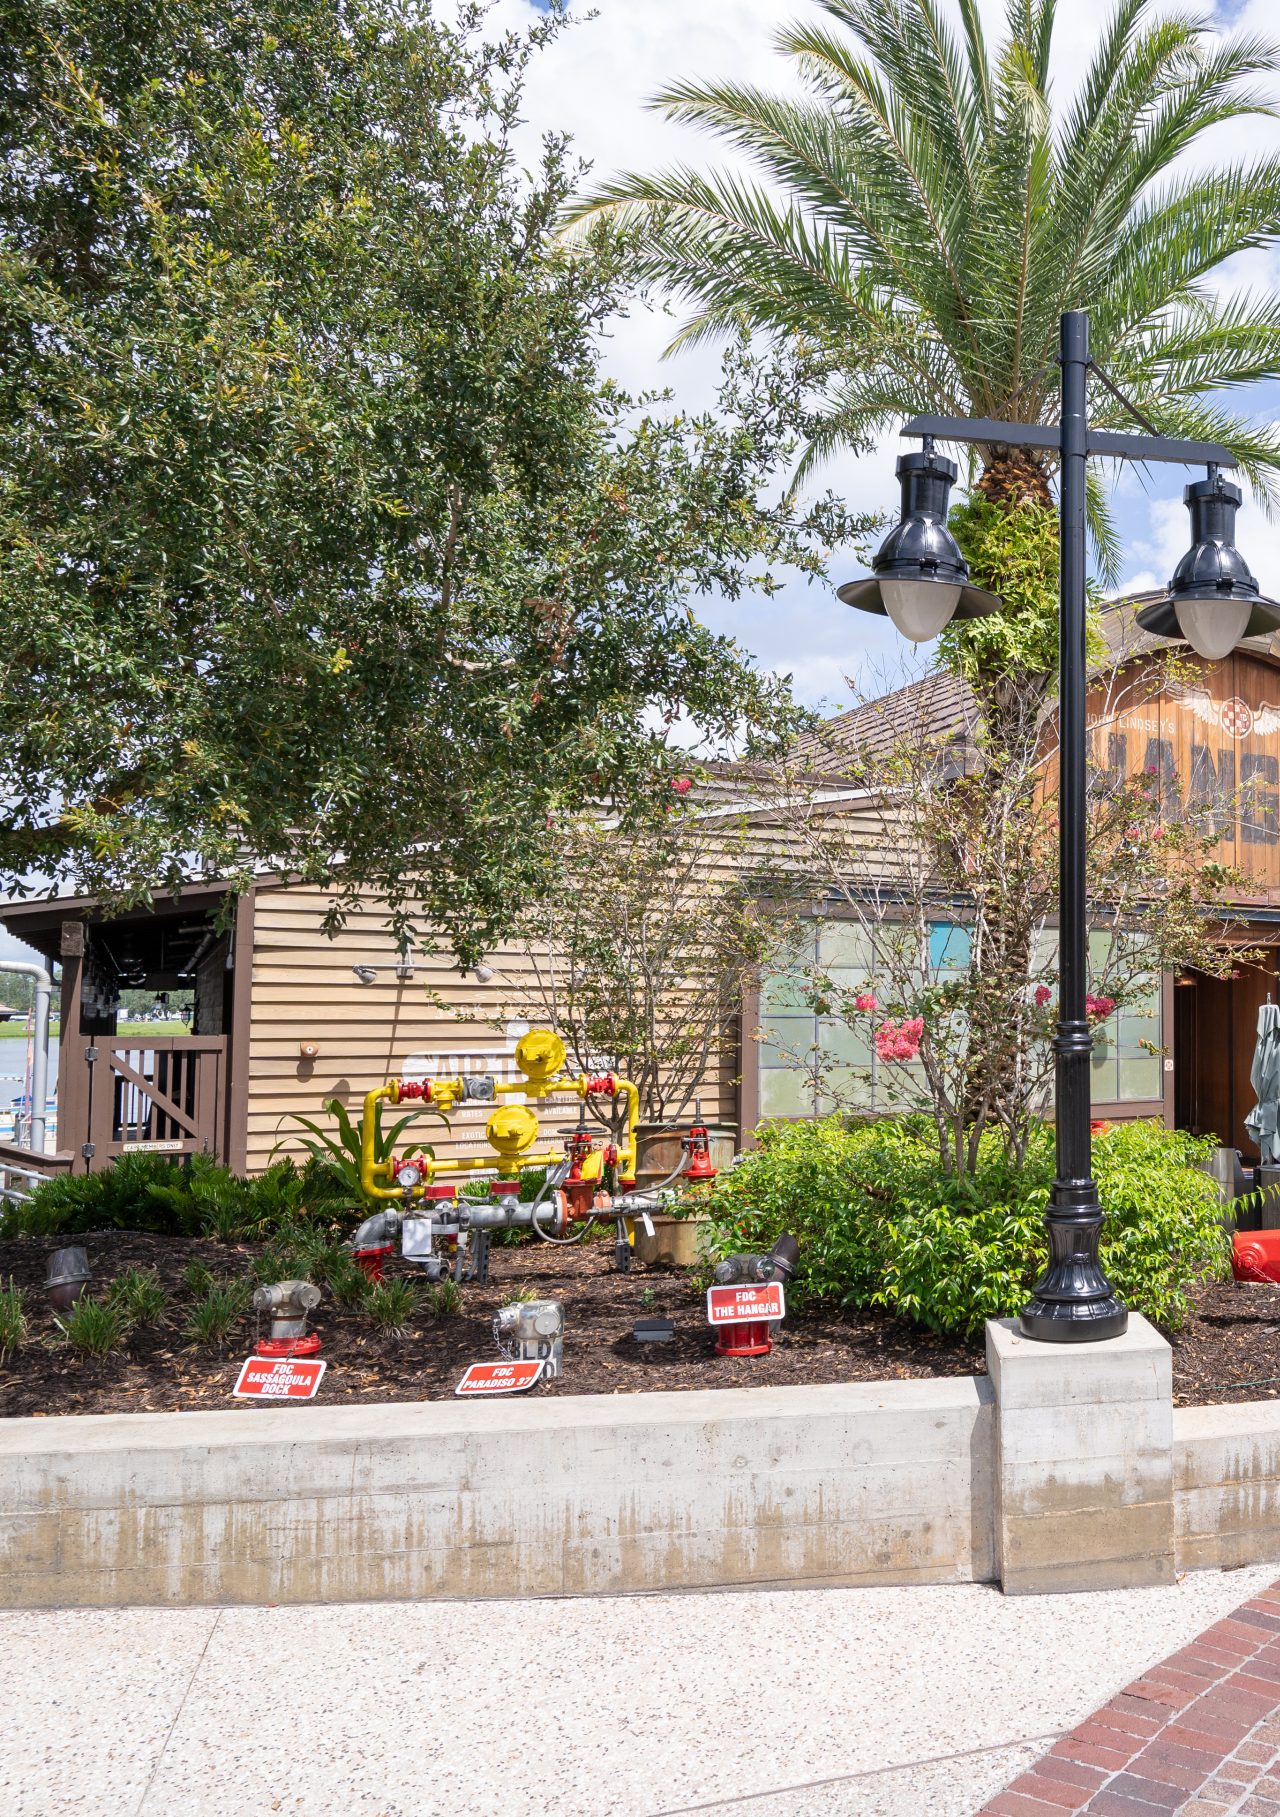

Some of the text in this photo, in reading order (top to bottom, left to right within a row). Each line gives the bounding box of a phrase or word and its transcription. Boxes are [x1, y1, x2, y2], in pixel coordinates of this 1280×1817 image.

[1119, 718, 1175, 734] LINDSEY'S
[544, 1107, 577, 1116] AVAILABLE
[462, 1131, 485, 1141] EXOTIC
[735, 1291, 757, 1303] FDC
[714, 1302, 779, 1318] THE HANGAR
[272, 1363, 294, 1375] FDC
[492, 1367, 514, 1378] FDC
[247, 1372, 312, 1386] SASSAGOULA
[463, 1376, 532, 1389] PARADISO 37
[260, 1383, 291, 1395] DOCK
